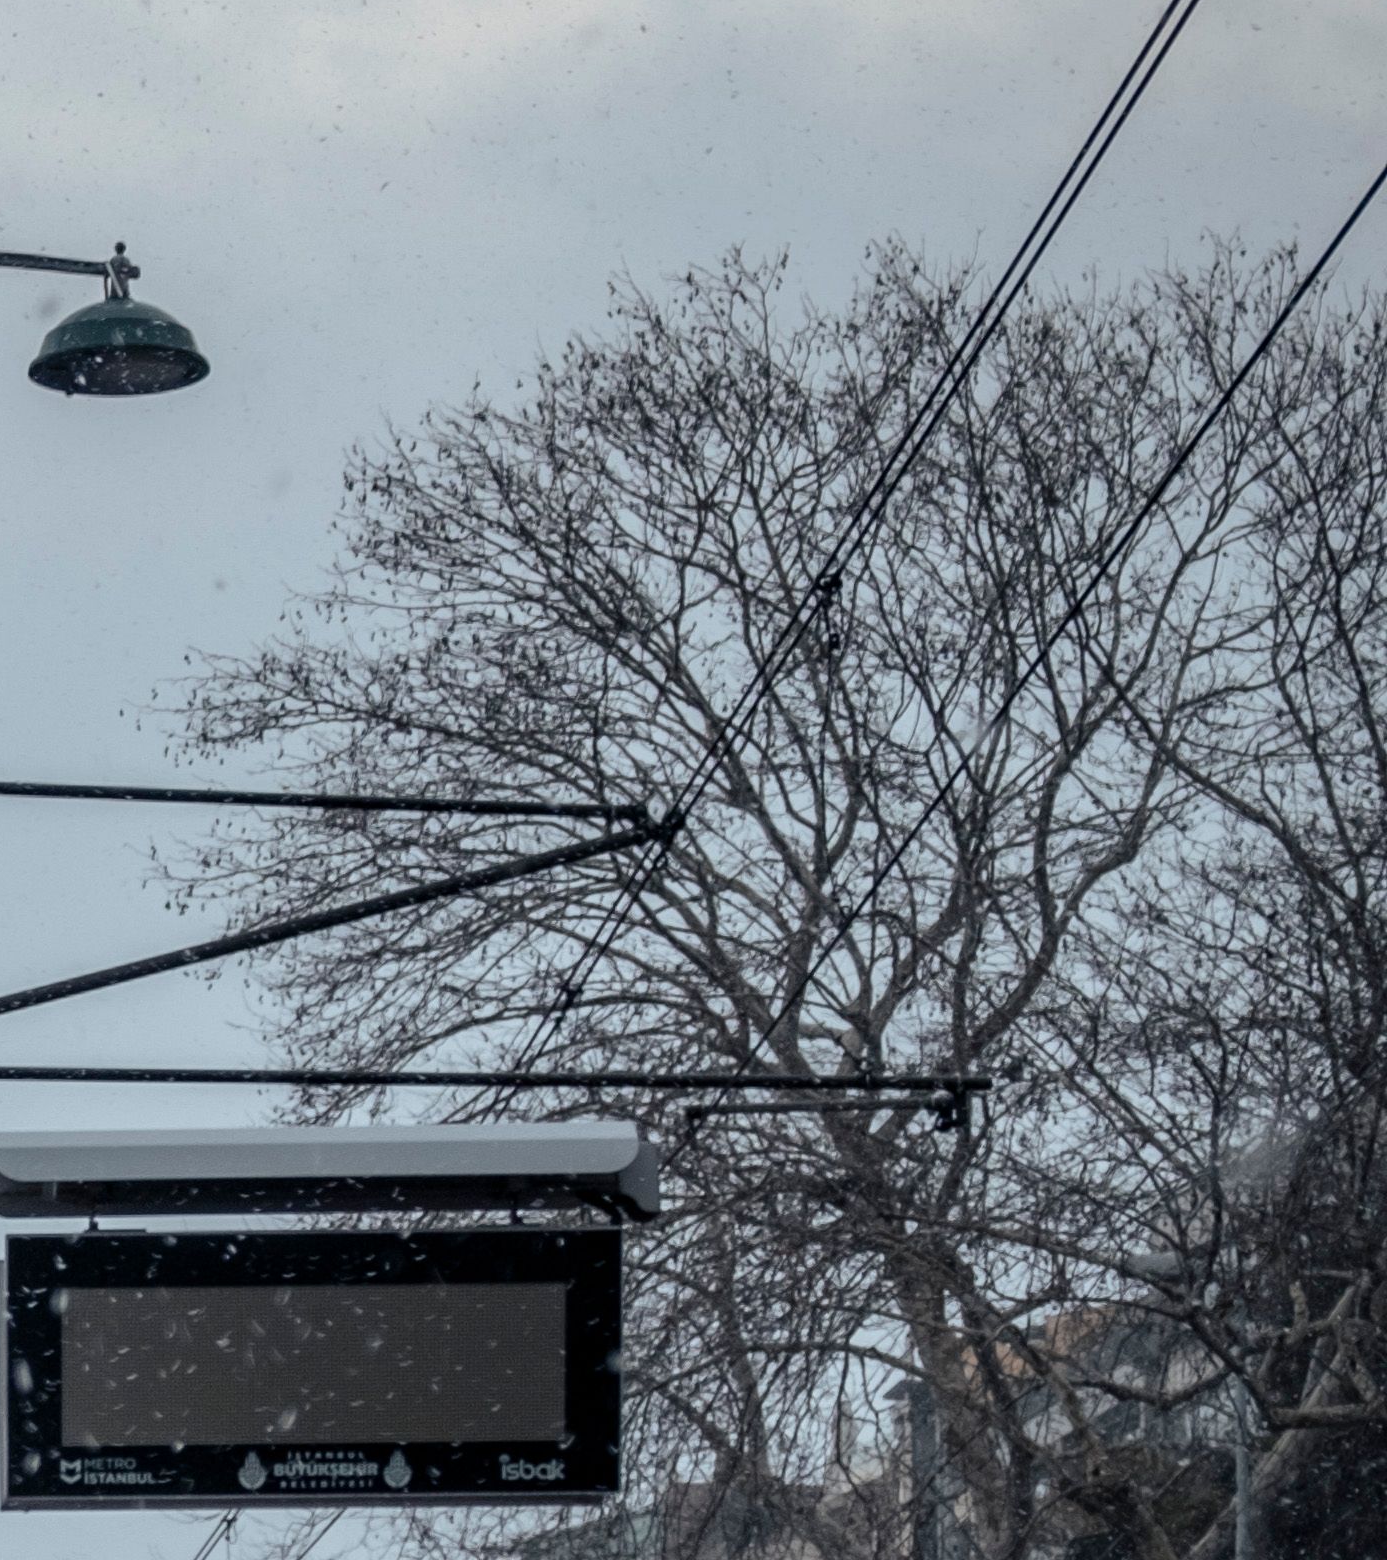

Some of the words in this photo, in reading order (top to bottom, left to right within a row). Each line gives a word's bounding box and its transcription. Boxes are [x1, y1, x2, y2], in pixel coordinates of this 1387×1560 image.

[84, 1457, 137, 1470] METRO
[273, 1460, 378, 1480] BÜYÜKŞEHİR
[84, 1470, 153, 1484] İSTANBUL
